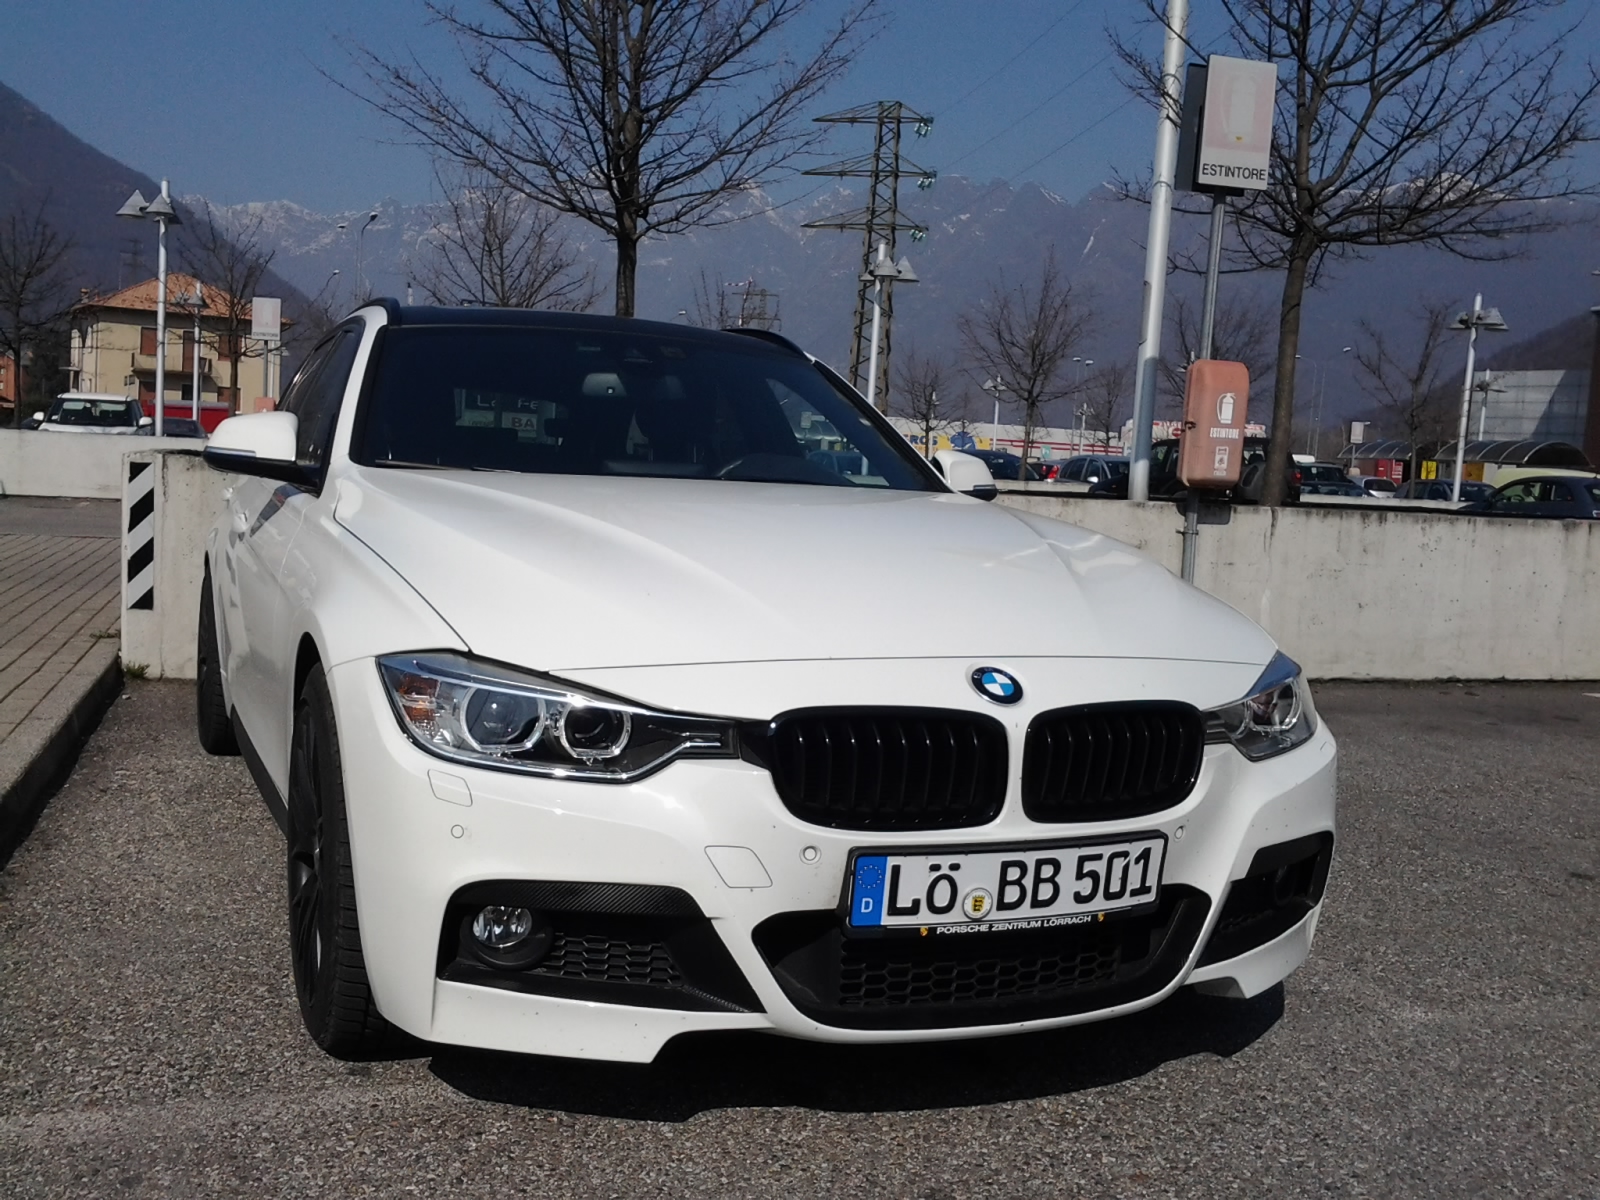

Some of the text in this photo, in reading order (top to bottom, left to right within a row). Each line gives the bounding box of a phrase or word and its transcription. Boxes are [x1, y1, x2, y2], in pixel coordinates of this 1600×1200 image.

[1202, 163, 1266, 181] ESTINTORE
[1209, 427, 1240, 439] ESTINTORE
[887, 847, 1152, 916] LÖ BB 501
[861, 897, 873, 913] D
[936, 914, 1092, 935] PORSCHE ZENTRUM LÖRRACH
